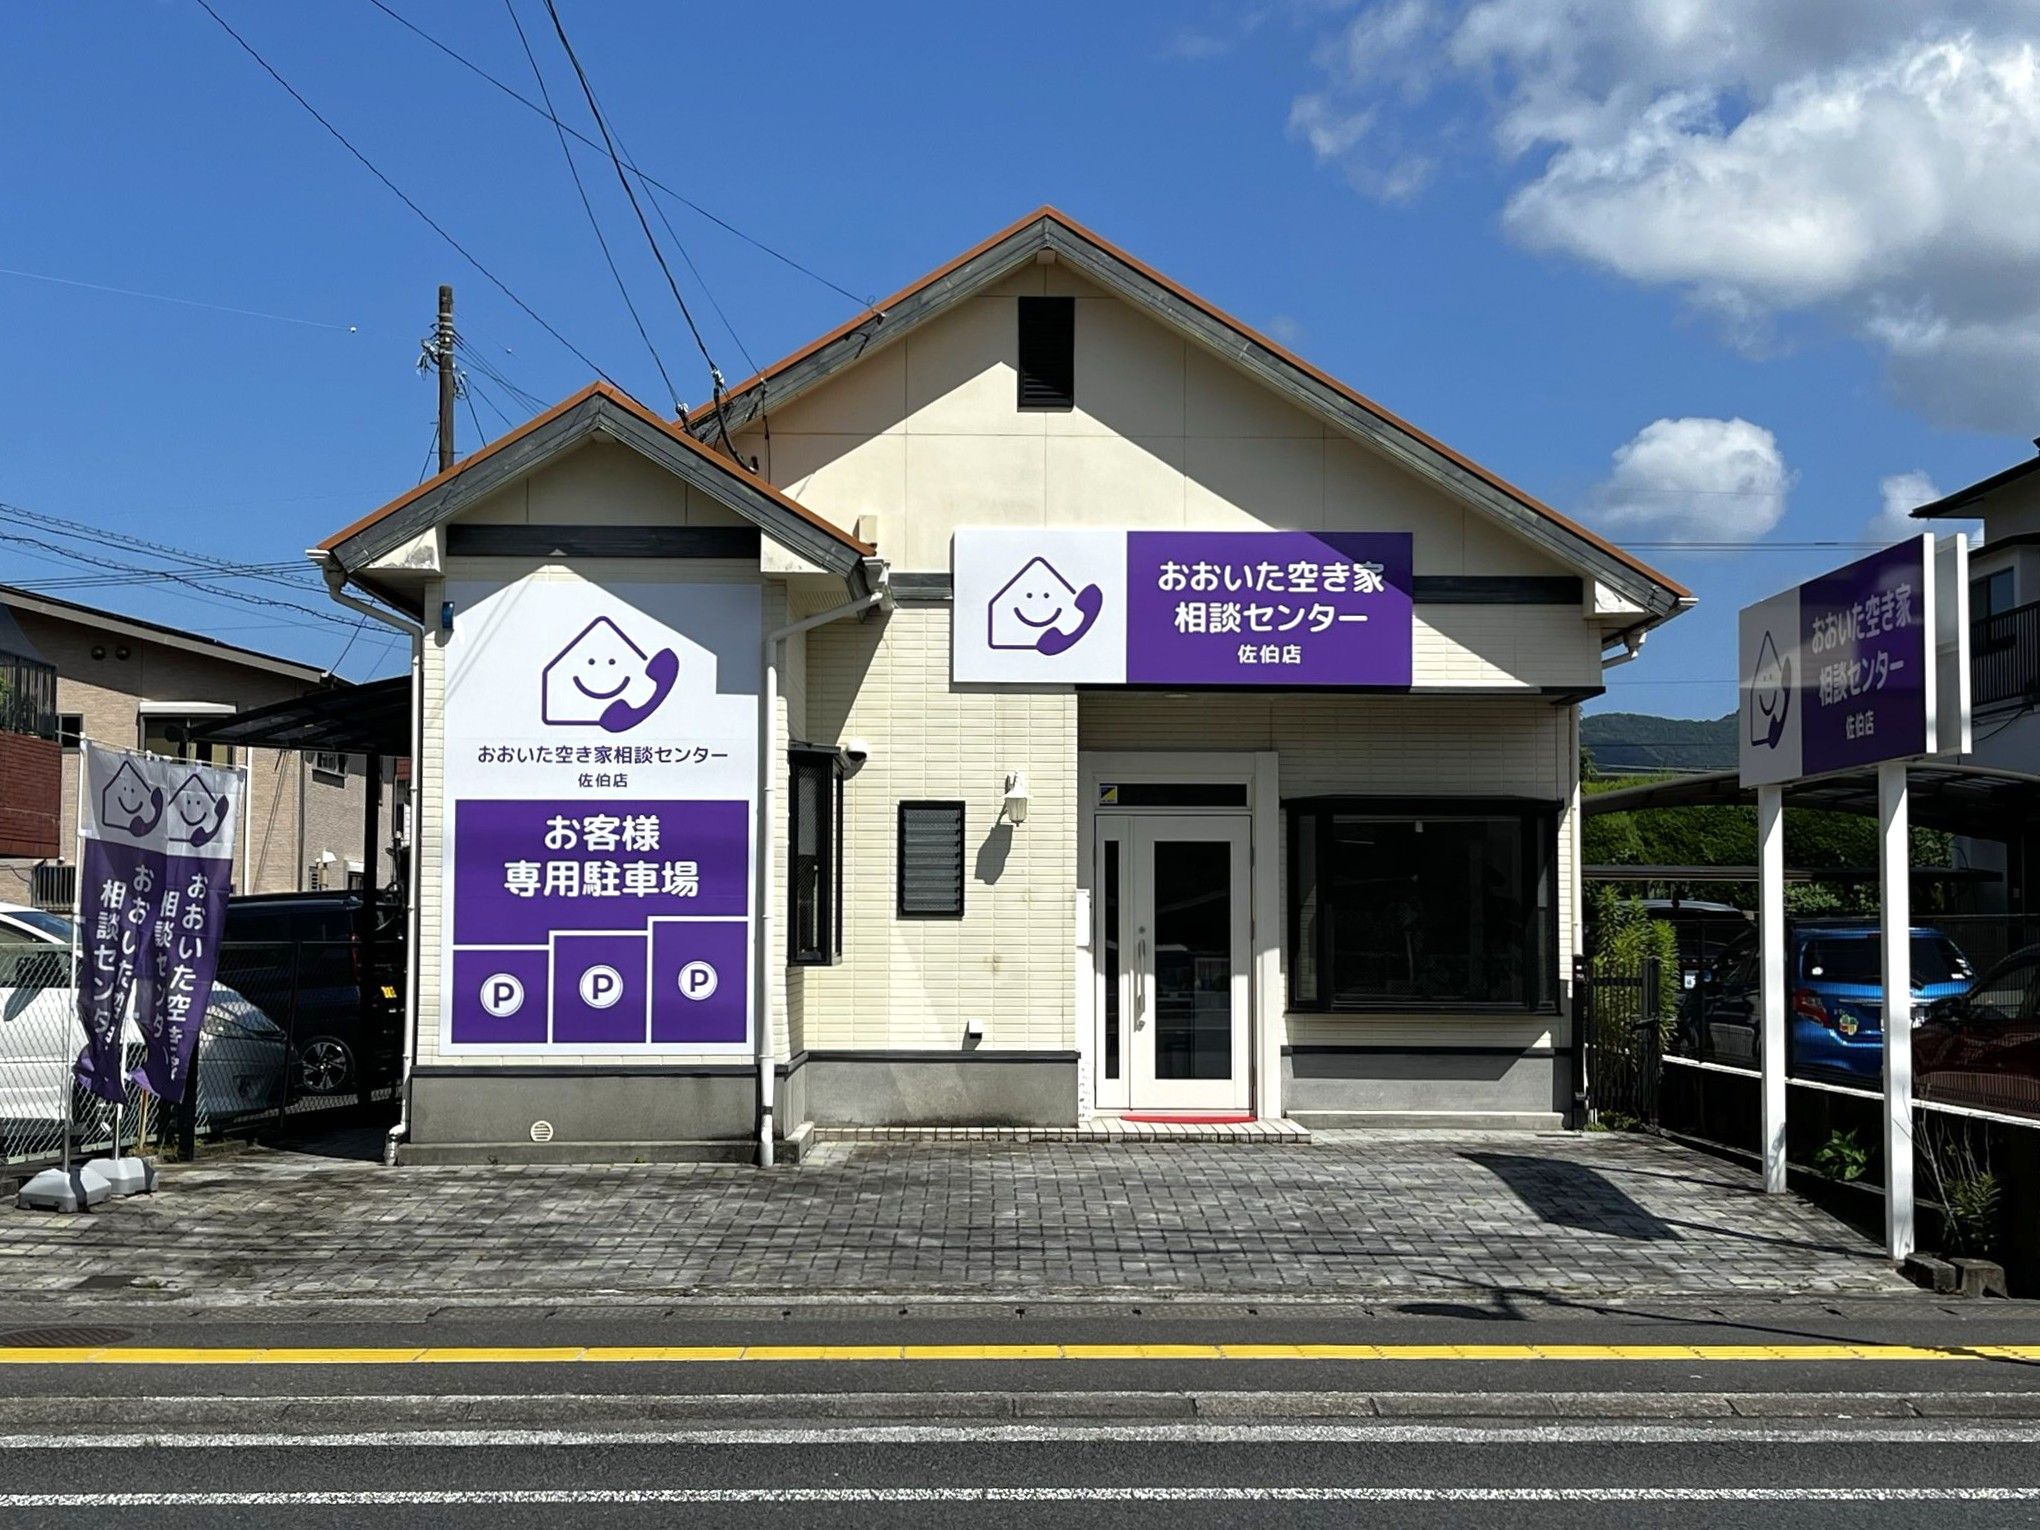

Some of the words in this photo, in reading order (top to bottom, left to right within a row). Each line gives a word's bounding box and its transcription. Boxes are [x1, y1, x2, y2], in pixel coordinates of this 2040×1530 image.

[1157, 560, 1385, 594] おおいた空き家
[1174, 601, 1368, 634] 相談センター
[1811, 582, 1913, 654] おおいた空き家
[1237, 644, 1302, 664] 佐伯店
[1818, 651, 1905, 708] 相談センター
[1845, 710, 1875, 741] 佐伯店
[478, 745, 728, 764] おおいた空き家相談センター
[578, 772, 628, 788] 佐伯店
[544, 813, 660, 852] お客様
[503, 859, 700, 898] 専用駐車場
[94, 879, 127, 1034] 相談センタ
[493, 982, 515, 1009] P
[592, 973, 614, 1000] P
[690, 968, 710, 993] P
